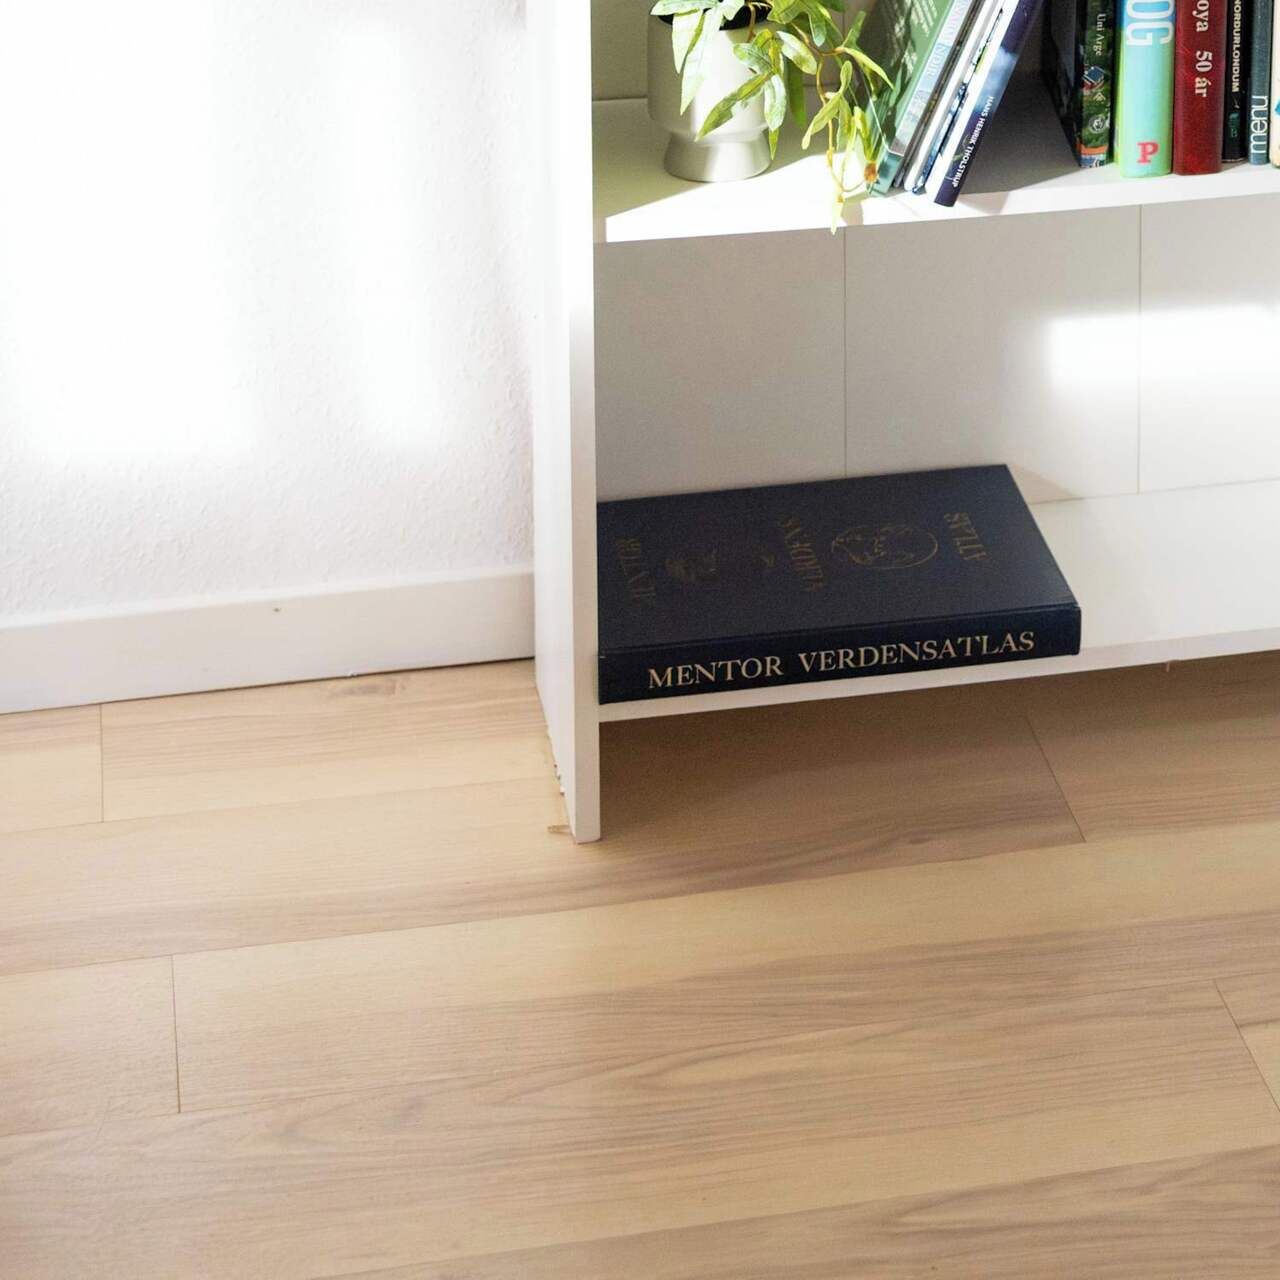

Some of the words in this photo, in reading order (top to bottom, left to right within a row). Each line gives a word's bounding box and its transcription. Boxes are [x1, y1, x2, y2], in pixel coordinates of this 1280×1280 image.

[1096, 13, 1106, 31] Uni
[1093, 34, 1105, 56] Arge
[1195, 50, 1213, 72] 50
[1194, 76, 1212, 98] ár
[982, 96, 995, 116] HANS
[969, 118, 986, 145] HENRIK
[1250, 95, 1268, 154] menu
[1136, 141, 1159, 164] P
[952, 145, 974, 188] THOLSTRUP
[646, 656, 784, 689] MENTOR
[798, 631, 1035, 674] VERDENSATLAS
